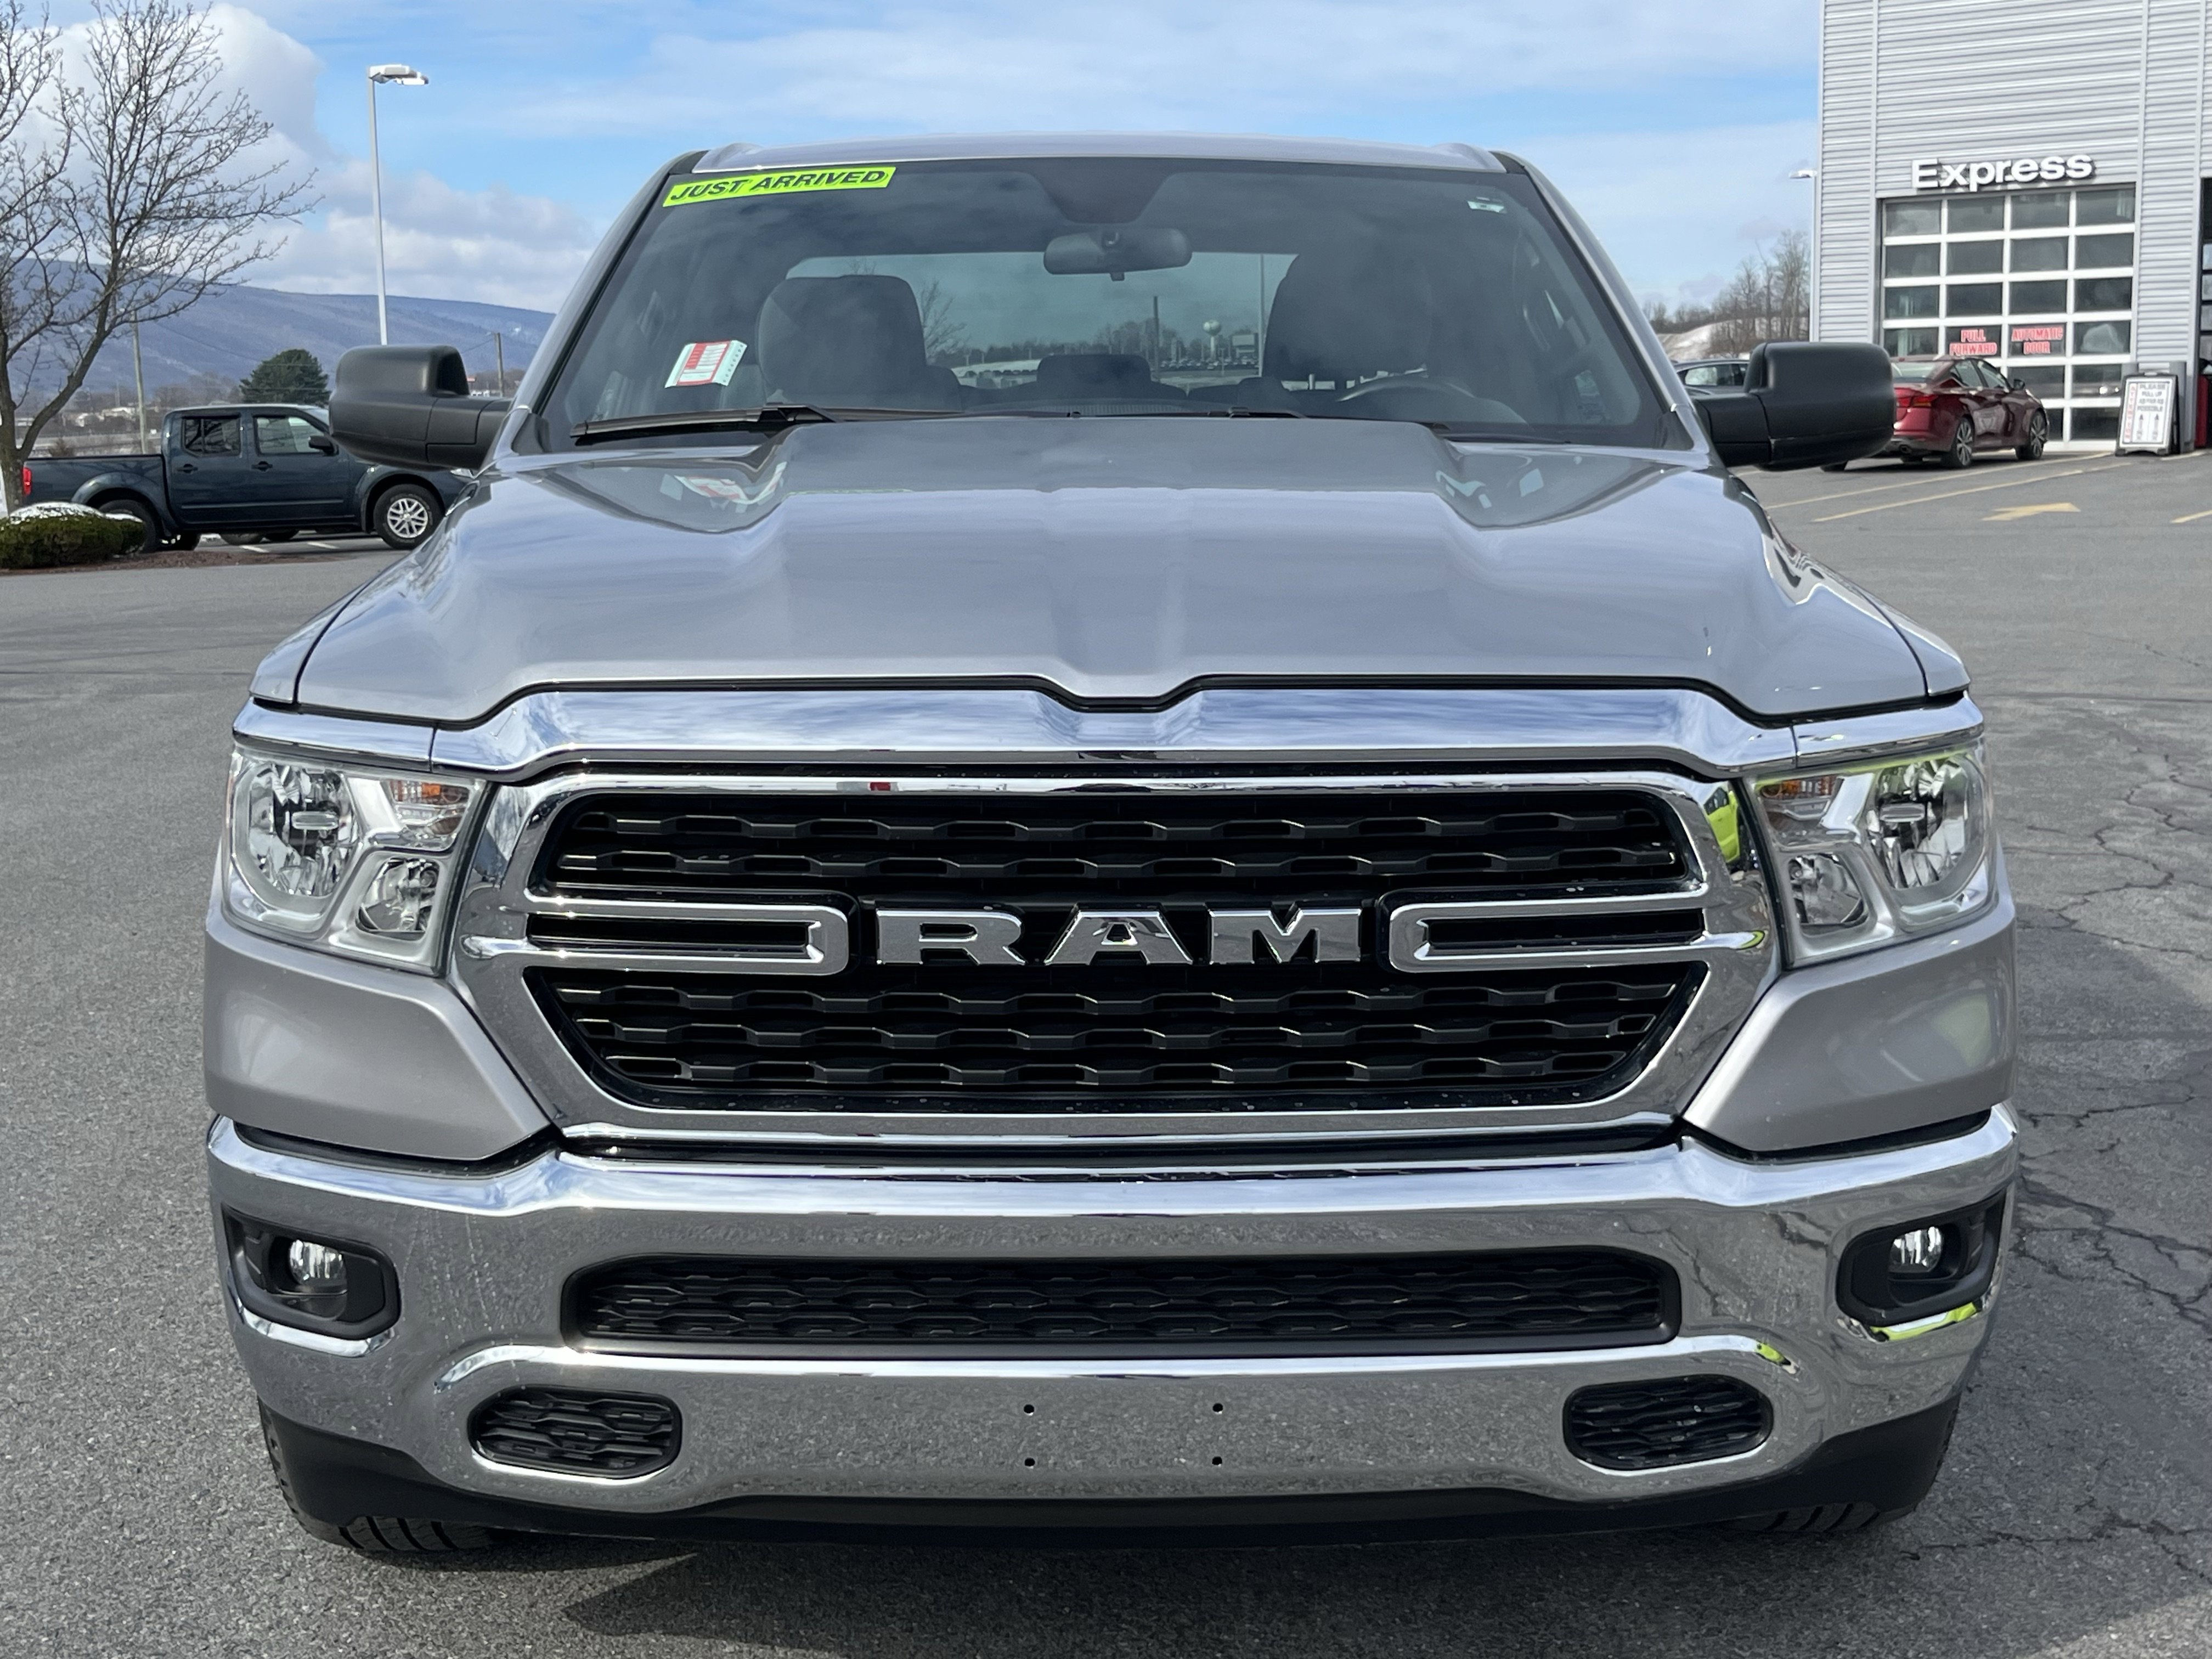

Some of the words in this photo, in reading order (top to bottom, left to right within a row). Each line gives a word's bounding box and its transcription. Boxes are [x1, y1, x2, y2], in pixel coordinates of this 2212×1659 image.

[1912, 154, 2094, 192] Express
[670, 178, 752, 201] JUST
[749, 170, 887, 191] ARRIVED
[1961, 329, 1986, 342] PULL
[2012, 327, 2063, 341] AUTOMATIC
[1950, 342, 1997, 356] FORWARD
[2023, 342, 2050, 354] DOOR
[876, 907, 1363, 966] RAM
